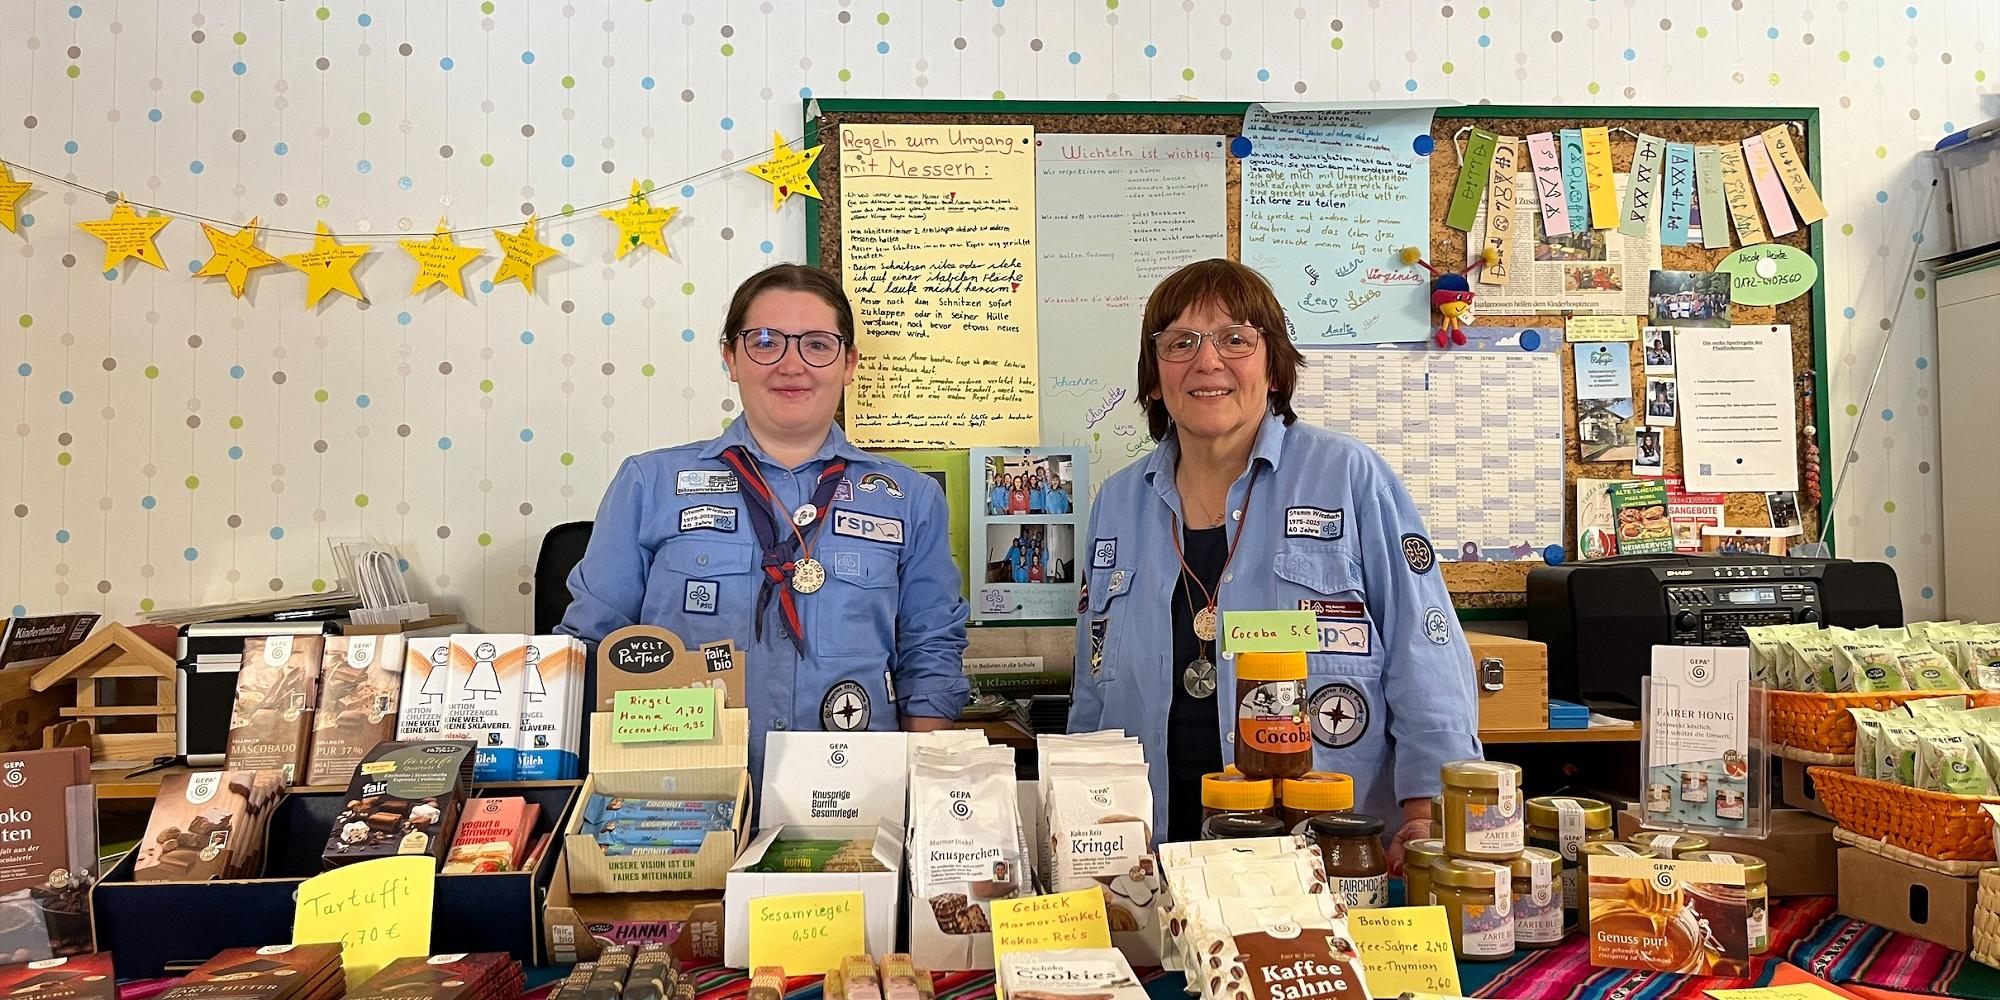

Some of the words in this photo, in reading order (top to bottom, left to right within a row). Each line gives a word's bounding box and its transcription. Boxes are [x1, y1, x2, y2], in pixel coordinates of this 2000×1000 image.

[843, 129, 896, 155] Regeln
[907, 136, 939, 148] zum
[949, 128, 1014, 155] Umgang
[1062, 145, 1133, 160] Wichteln
[1142, 147, 1158, 160] ist
[1168, 148, 1214, 162] wichtig:
[844, 158, 879, 173] mit
[889, 156, 976, 177] Messern
[1250, 196, 1266, 205] Ich
[1316, 199, 1347, 209] teilen
[1296, 225, 1311, 234] und
[1321, 225, 1338, 236] das
[1366, 268, 1420, 282] Virginia
[939, 297, 982, 308] Schnitzen
[988, 298, 1012, 308] sofort
[1303, 293, 1328, 307] Lea
[935, 311, 943, 319] in
[951, 311, 978, 321] seiner
[986, 311, 1010, 321] Hülle
[1615, 488, 1630, 496] ALTE
[836, 514, 876, 535] rsp
[1621, 541, 1673, 552] HEIMSERVICE
[1231, 626, 1278, 639] Cocoba
[630, 641, 664, 651] WELT
[618, 649, 672, 667] Partner
[1689, 658, 1711, 666] GEPA
[713, 658, 732, 671] bio
[630, 696, 672, 709] Riegel
[675, 706, 705, 718] 1,70
[1657, 708, 1695, 719] FAIRER
[1698, 710, 1734, 721] HONIG
[467, 722, 512, 730] SKLAVEREI.
[1254, 727, 1312, 744] Cocoba
[231, 743, 297, 755] MASCOBADO
[317, 746, 337, 756] PUR
[340, 746, 364, 755] 37%
[4, 761, 25, 769] GEPA
[362, 782, 388, 794] fair
[812, 790, 851, 801] Knusprige
[949, 790, 972, 799] GEPA
[645, 800, 683, 809] COCONUT
[811, 799, 838, 809] Barrita
[811, 808, 859, 819] Sesamriegel
[461, 820, 491, 830] yogurt
[641, 820, 680, 828] COCONUT
[460, 828, 513, 838] strawberry
[1070, 829, 1088, 838] Kokos
[1484, 832, 1509, 840] ZARTE
[1071, 836, 1125, 858] Kringel
[930, 848, 1000, 865] Knusperchen
[608, 861, 639, 870] UNSERE
[641, 860, 667, 870] VISION
[668, 860, 681, 868] IST
[682, 859, 695, 868] EIN
[1653, 863, 1676, 872] GEPA
[613, 872, 640, 882] FAIRES
[641, 871, 695, 882] MITEINANDER.
[1338, 879, 1379, 892] FAIRCHOC
[304, 876, 411, 918] Tartuffi
[760, 899, 852, 922] Sesamriegel
[1012, 896, 1071, 913] Gebäck
[1357, 915, 1414, 927] Bonbons
[1518, 920, 1545, 929] ZARTE
[385, 922, 401, 939] €
[615, 923, 669, 940] HANNA
[1597, 930, 1639, 945] Genuss
[1642, 935, 1669, 950] pur!
[1016, 969, 1117, 981] Cookies
[1261, 960, 1343, 983] Kaffee
[1270, 978, 1349, 1000] Sahne
[1425, 977, 1451, 990] 2,60
